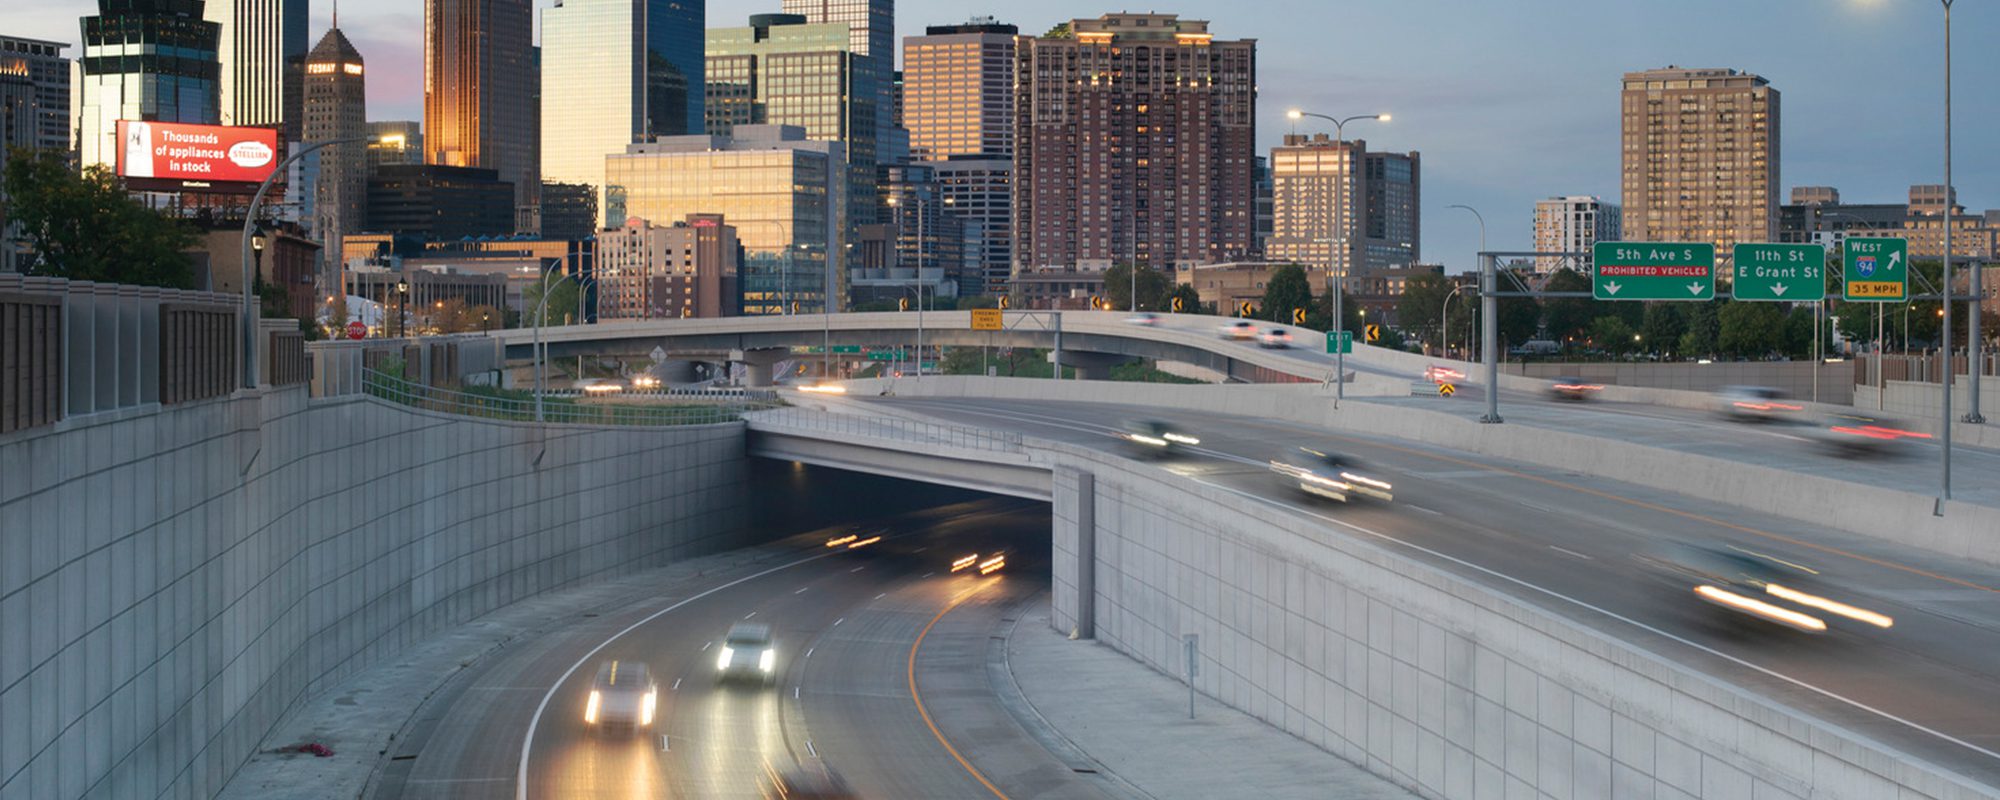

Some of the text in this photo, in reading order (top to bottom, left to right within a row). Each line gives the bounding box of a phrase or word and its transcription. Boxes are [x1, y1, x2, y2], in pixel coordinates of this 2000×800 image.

[162, 130, 218, 144] Thousands
[155, 145, 224, 159] of appliances
[170, 160, 211, 173] in stock
[1851, 242, 1882, 252] WEST
[1616, 249, 1692, 261] 5th Ave S
[1755, 250, 1804, 262] 11th St
[1600, 266, 1707, 275] PROHIBITED VEHICLES
[1739, 266, 1819, 278] E Grant St
[1858, 262, 1873, 273] 94
[1854, 284, 1897, 294] 35 MPH
[348, 326, 366, 336] STOP
